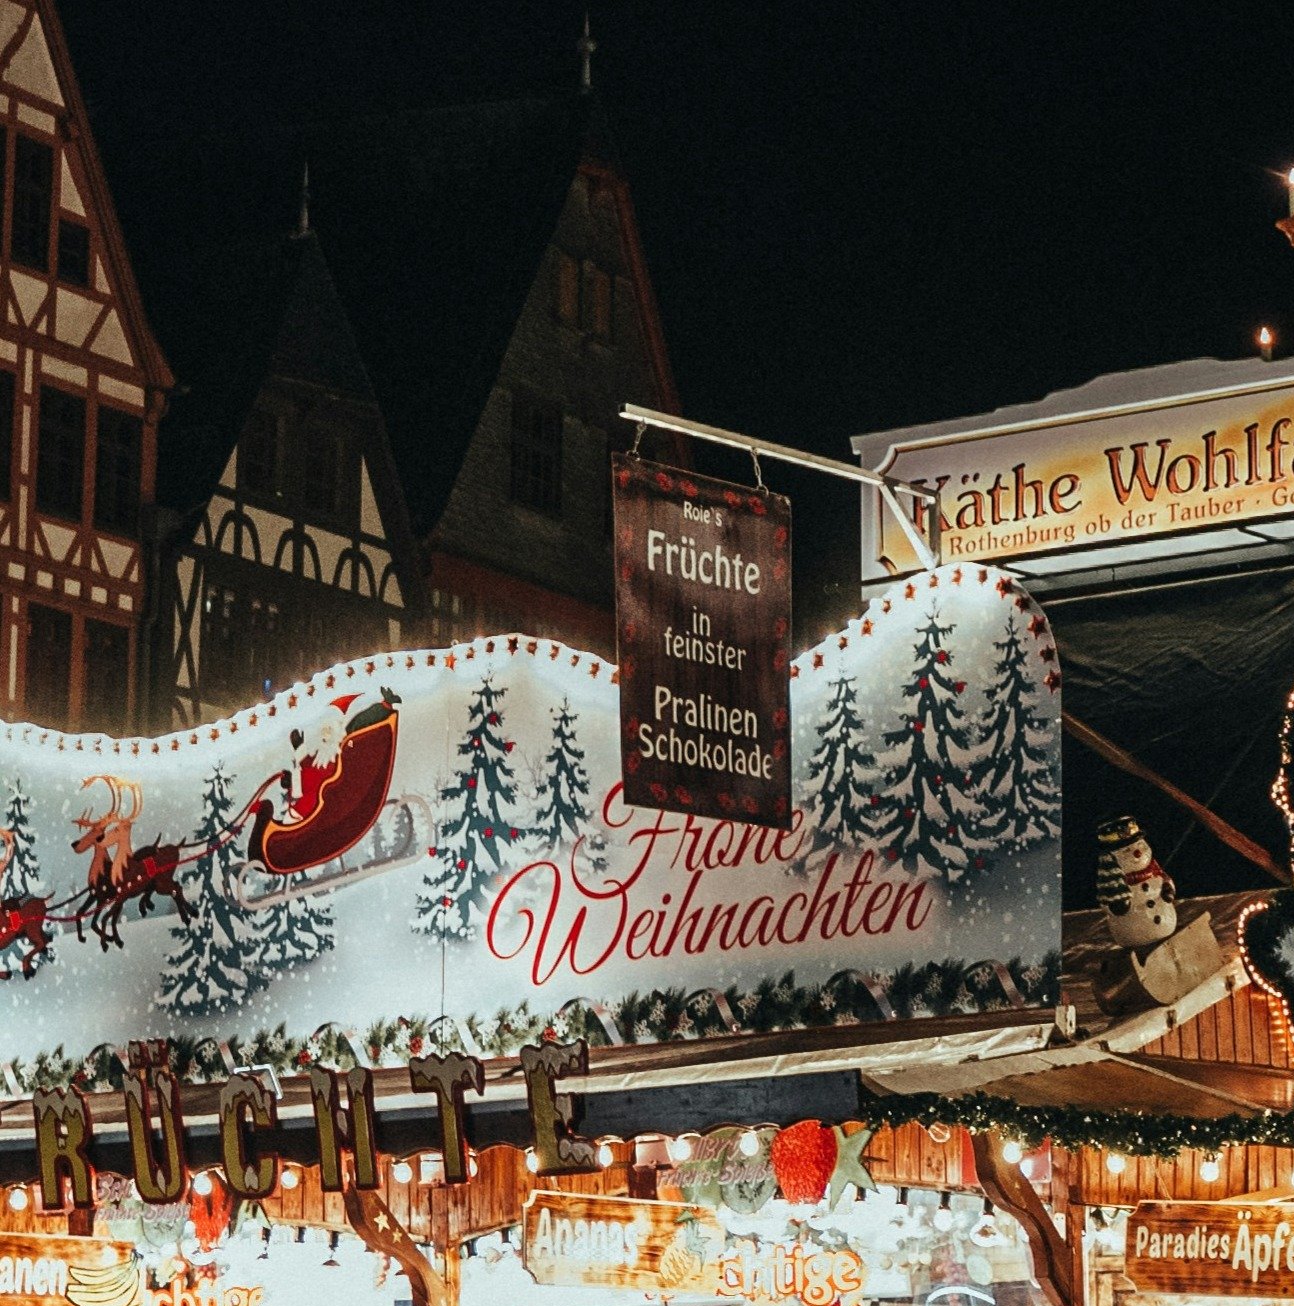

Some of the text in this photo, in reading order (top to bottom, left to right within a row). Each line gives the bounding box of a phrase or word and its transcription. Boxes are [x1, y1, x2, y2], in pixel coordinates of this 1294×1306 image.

[910, 463, 1083, 535] Käthe
[950, 525, 1076, 556] Rothenburg
[1085, 514, 1112, 535] ob
[1121, 509, 1158, 530] der
[1166, 496, 1246, 523] Tauber
[647, 529, 761, 595] Früchte
[664, 626, 747, 670] feinster
[692, 606, 711, 638] in
[654, 685, 758, 739] Pralinen
[638, 723, 774, 780] Schokolade
[486, 849, 935, 986] Weihnachten
[533, 1207, 638, 1267] Ananas
[1135, 1225, 1230, 1261] Paradies
[718, 1240, 861, 1306] chtige
